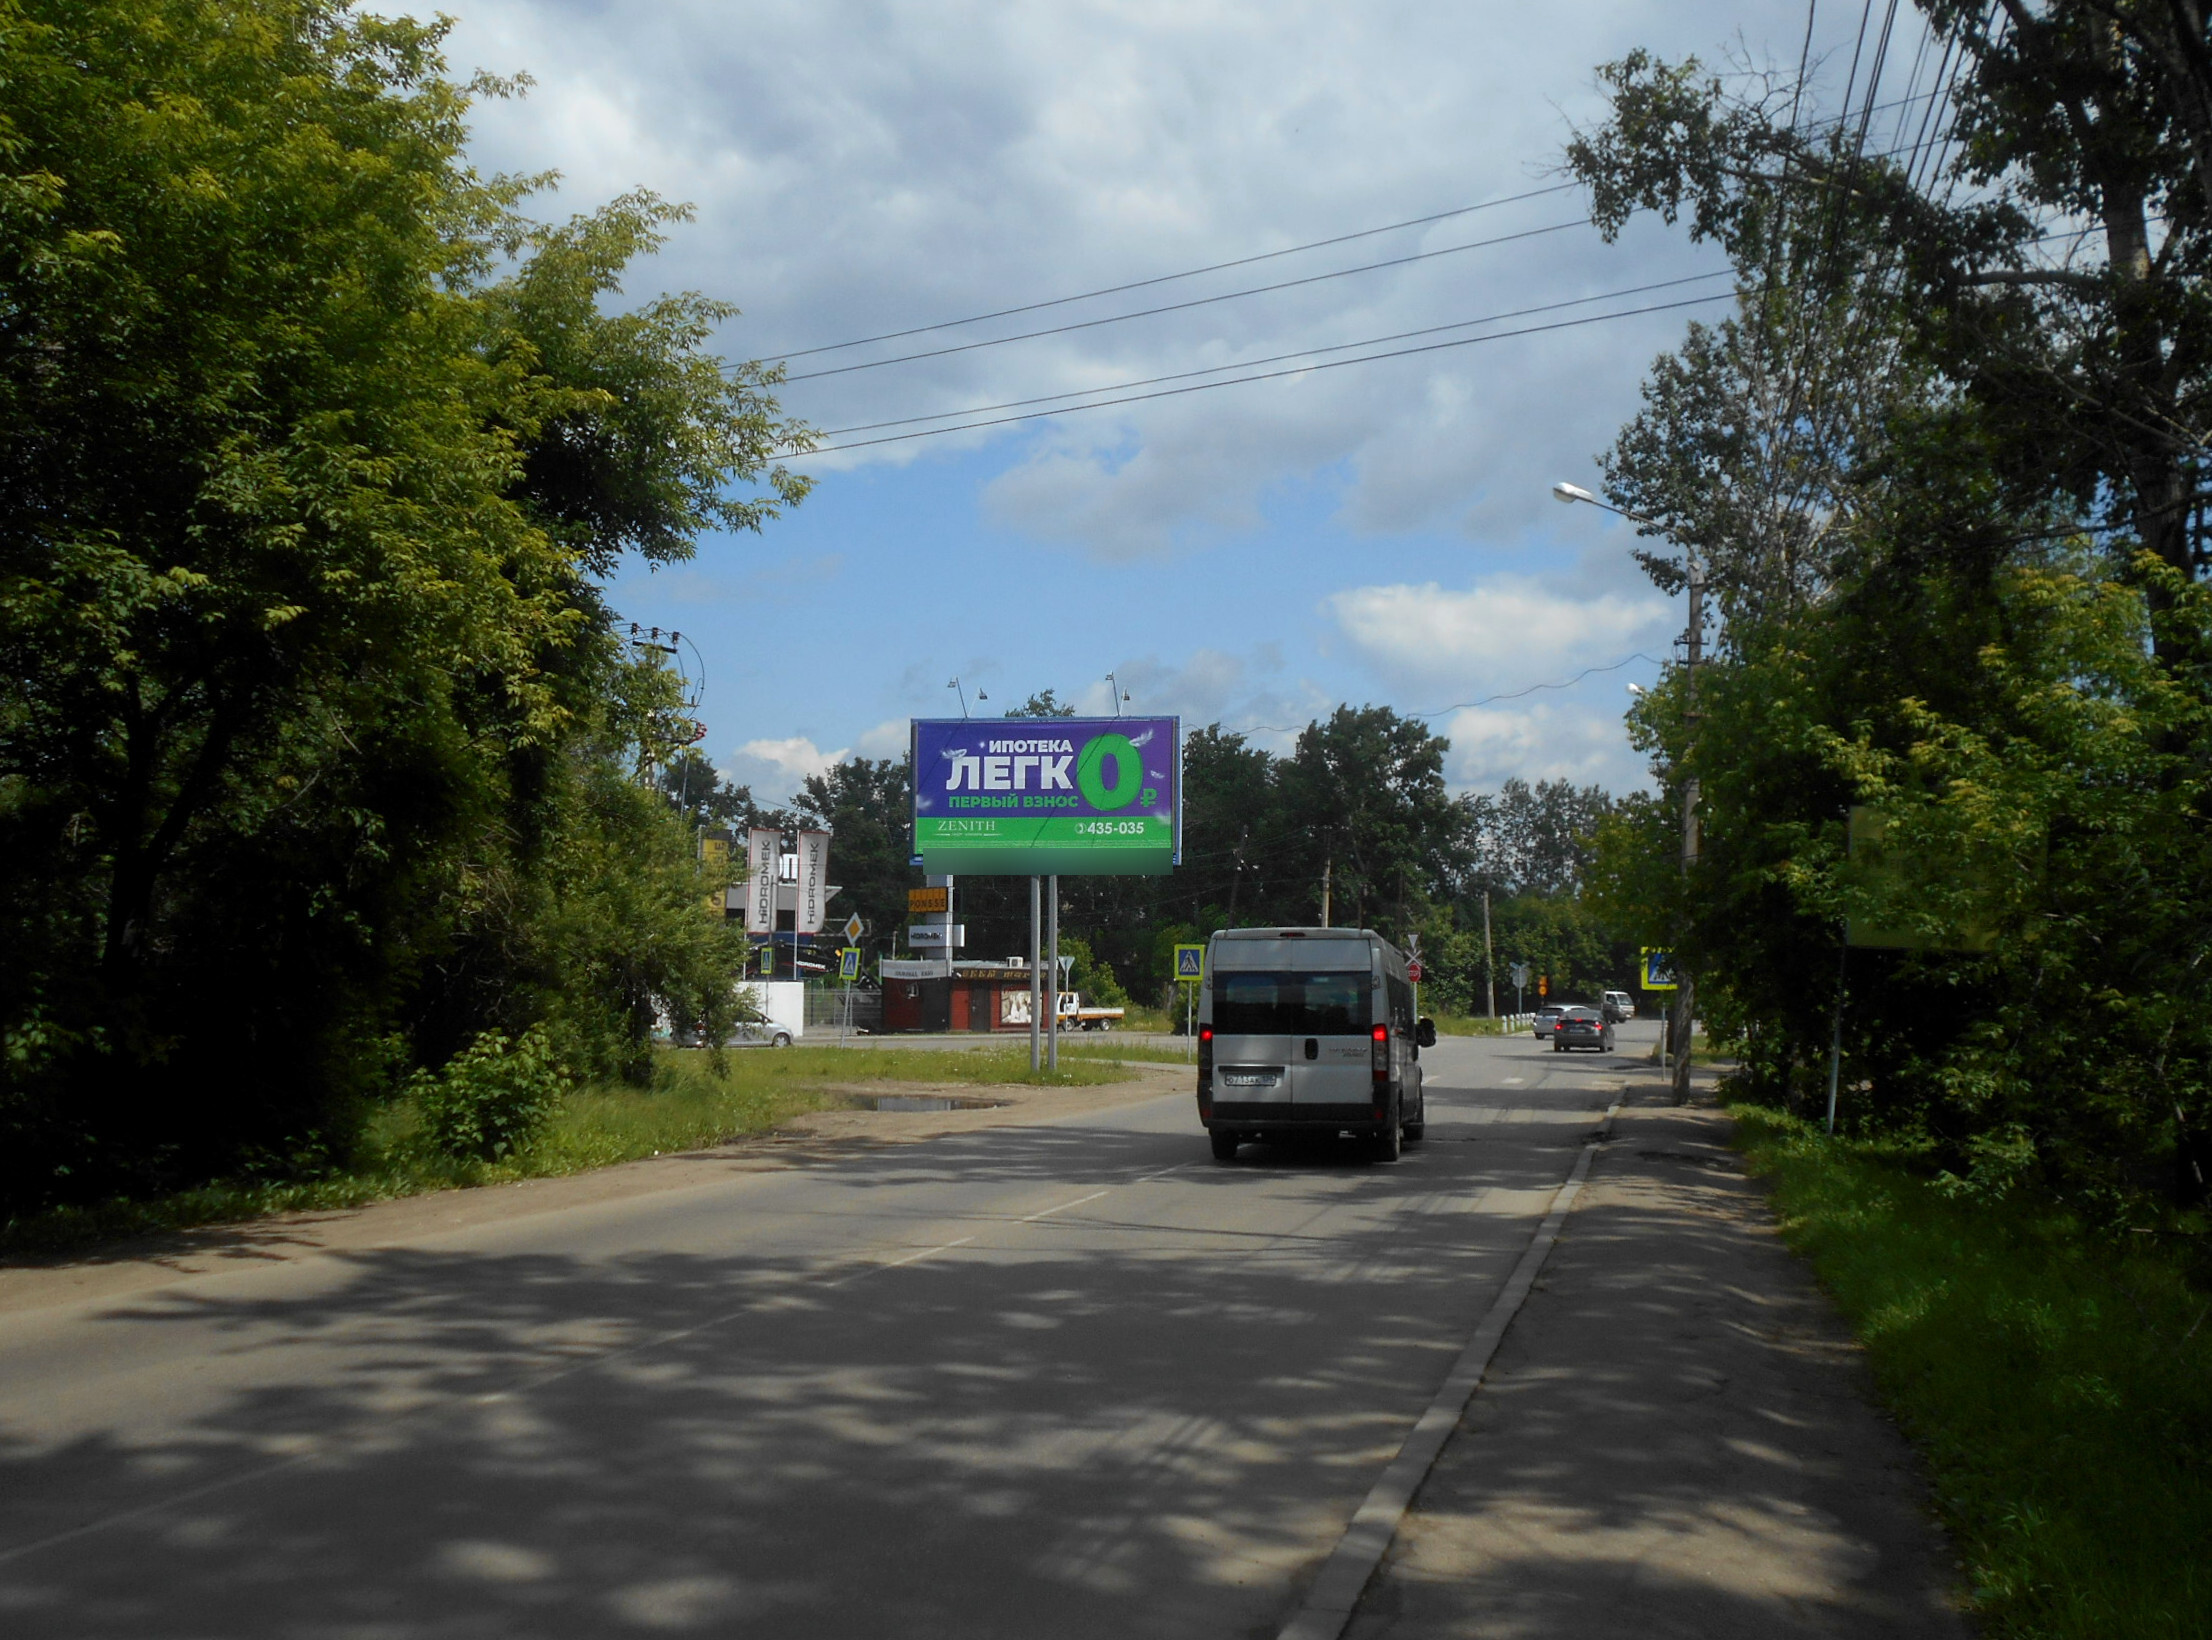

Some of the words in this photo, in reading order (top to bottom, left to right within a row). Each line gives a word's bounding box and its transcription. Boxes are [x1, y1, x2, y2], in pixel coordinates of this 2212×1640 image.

[989, 739, 1073, 754] ИПОТЕКА
[948, 793, 1019, 809] ПЕРВЫЙ
[1023, 795, 1079, 809] ВЗНОС
[938, 820, 996, 831] ZENITH
[1087, 822, 1144, 835] 435-035
